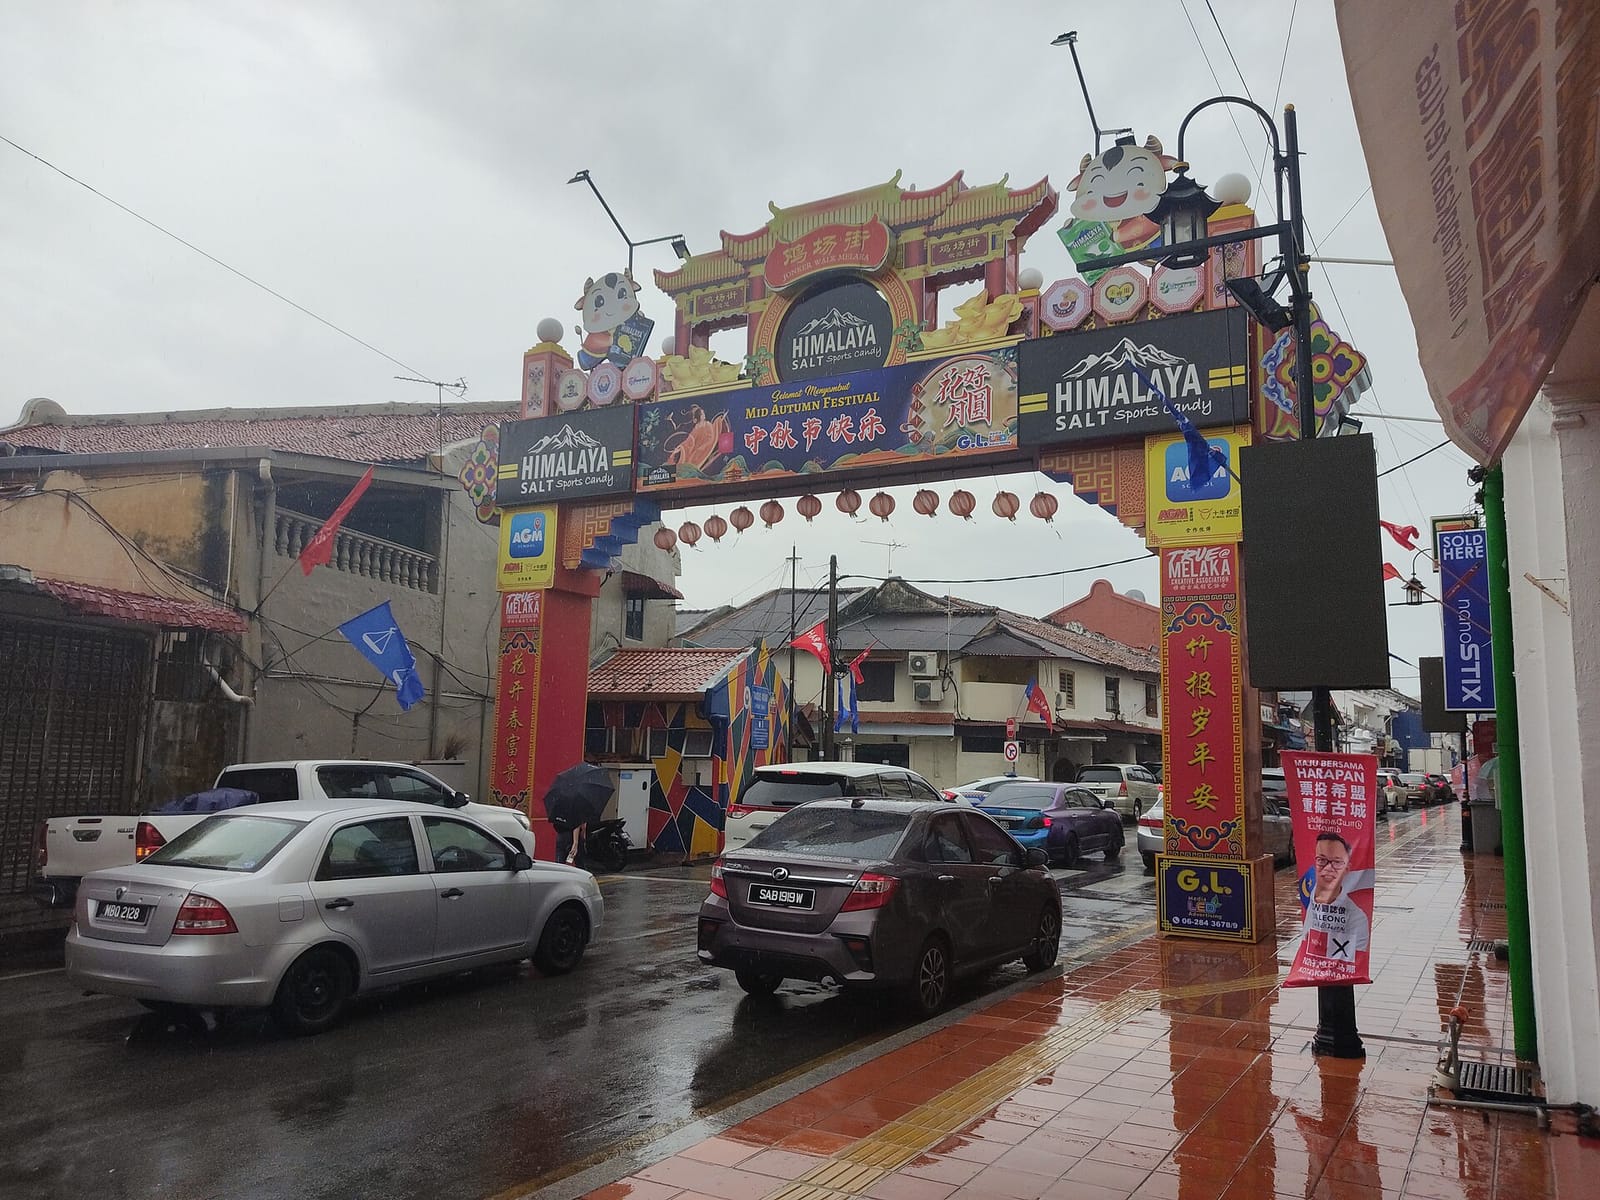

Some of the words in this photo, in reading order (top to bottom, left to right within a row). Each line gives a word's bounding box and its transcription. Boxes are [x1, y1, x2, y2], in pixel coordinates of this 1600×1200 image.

[783, 229, 871, 265] 鸡场街
[783, 262, 812, 281] JONKER
[815, 257, 836, 267] WALK
[792, 324, 876, 359] HIMALAYA
[791, 355, 824, 370] SALT
[826, 352, 852, 363] Sports
[771, 389, 803, 402] Selamat
[805, 382, 851, 397] Menyambut
[1055, 363, 1202, 414] HIMALAYA
[1055, 409, 1109, 431] SALT
[1113, 405, 1159, 423] Sports
[744, 408, 886, 455] 中秋节快乐
[957, 434, 989, 449] G.L.
[521, 446, 608, 480] HIMALAYA
[520, 480, 554, 494] SALT
[555, 478, 583, 491] Sports
[512, 528, 542, 544] AGM
[1443, 534, 1483, 549] SOLD
[1443, 546, 1484, 561] HERE
[1168, 559, 1231, 578] MELAKA
[506, 600, 539, 614] MELAKA
[1458, 599, 1482, 703] nanoSTIX
[503, 652, 526, 784] 花开春富贵
[1184, 634, 1219, 812] 竹报岁平安
[1294, 759, 1319, 767] MAJU
[1321, 760, 1364, 771] BERSAMA
[1296, 768, 1365, 783] HARAPAN
[1299, 781, 1366, 801] 票投希盟
[1302, 798, 1366, 819] 重振古城
[1177, 869, 1232, 895] G.L.
[121, 906, 140, 920] 2128
[1187, 900, 1216, 914] LED
[1188, 912, 1222, 920] Advertising
[1319, 915, 1346, 924] LEONG
